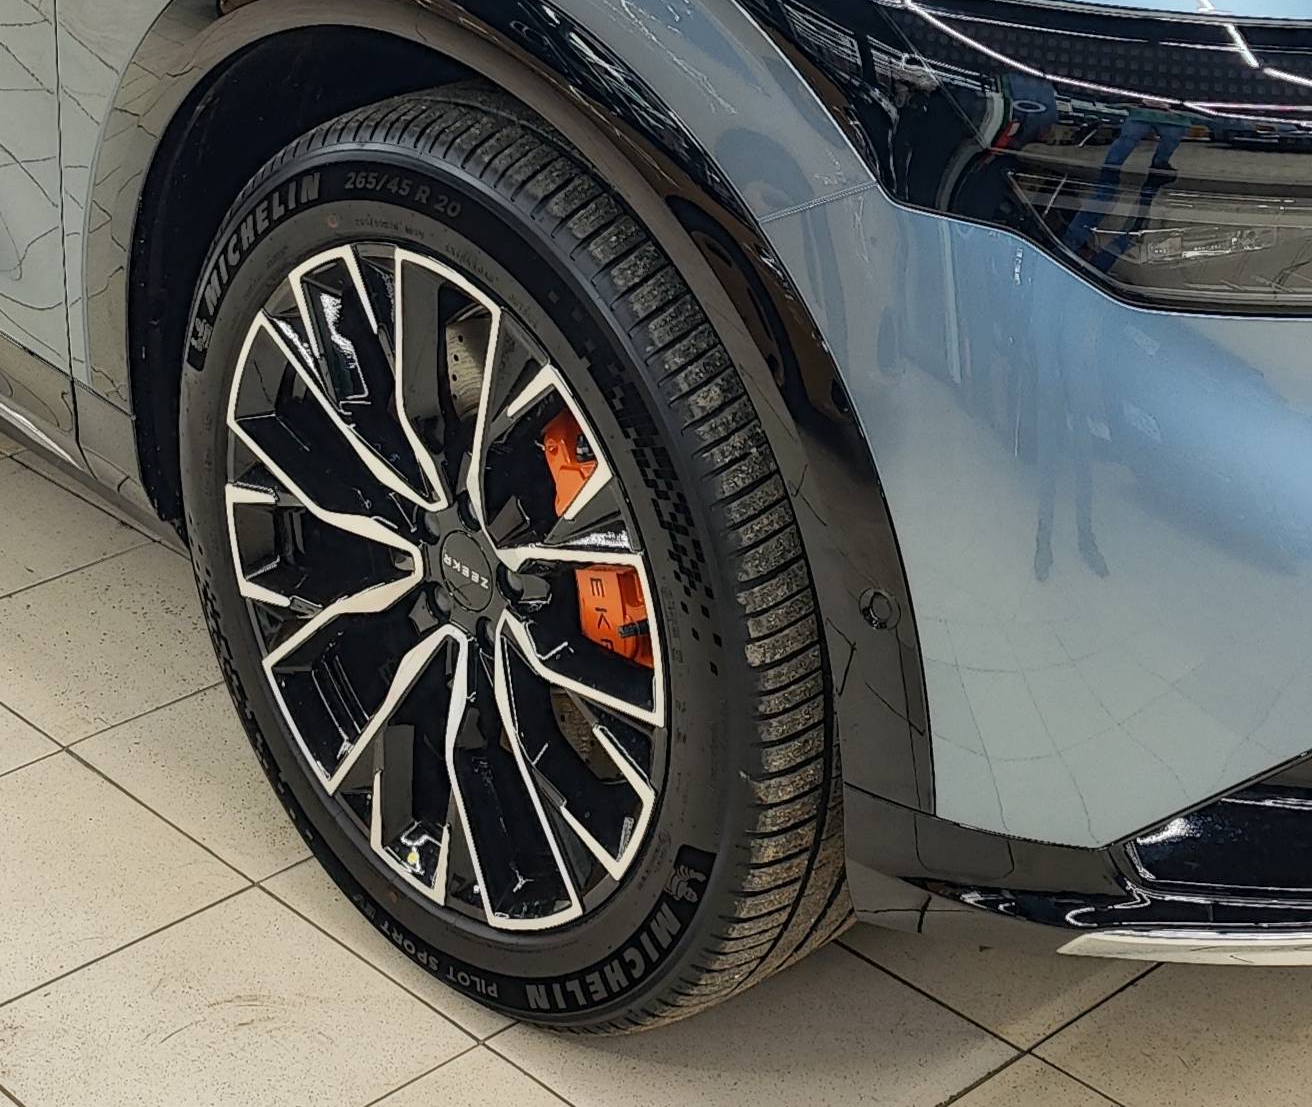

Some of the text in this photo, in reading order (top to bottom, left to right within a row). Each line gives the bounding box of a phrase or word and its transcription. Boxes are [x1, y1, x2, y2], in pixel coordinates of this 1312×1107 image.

[344, 171, 462, 218] 265/45 R 20
[204, 171, 321, 316] MICHELIN
[442, 551, 489, 590] ZEEKR
[380, 920, 439, 972] SPORT
[525, 901, 682, 1010] MICHELIN
[446, 966, 499, 998] PILOT
